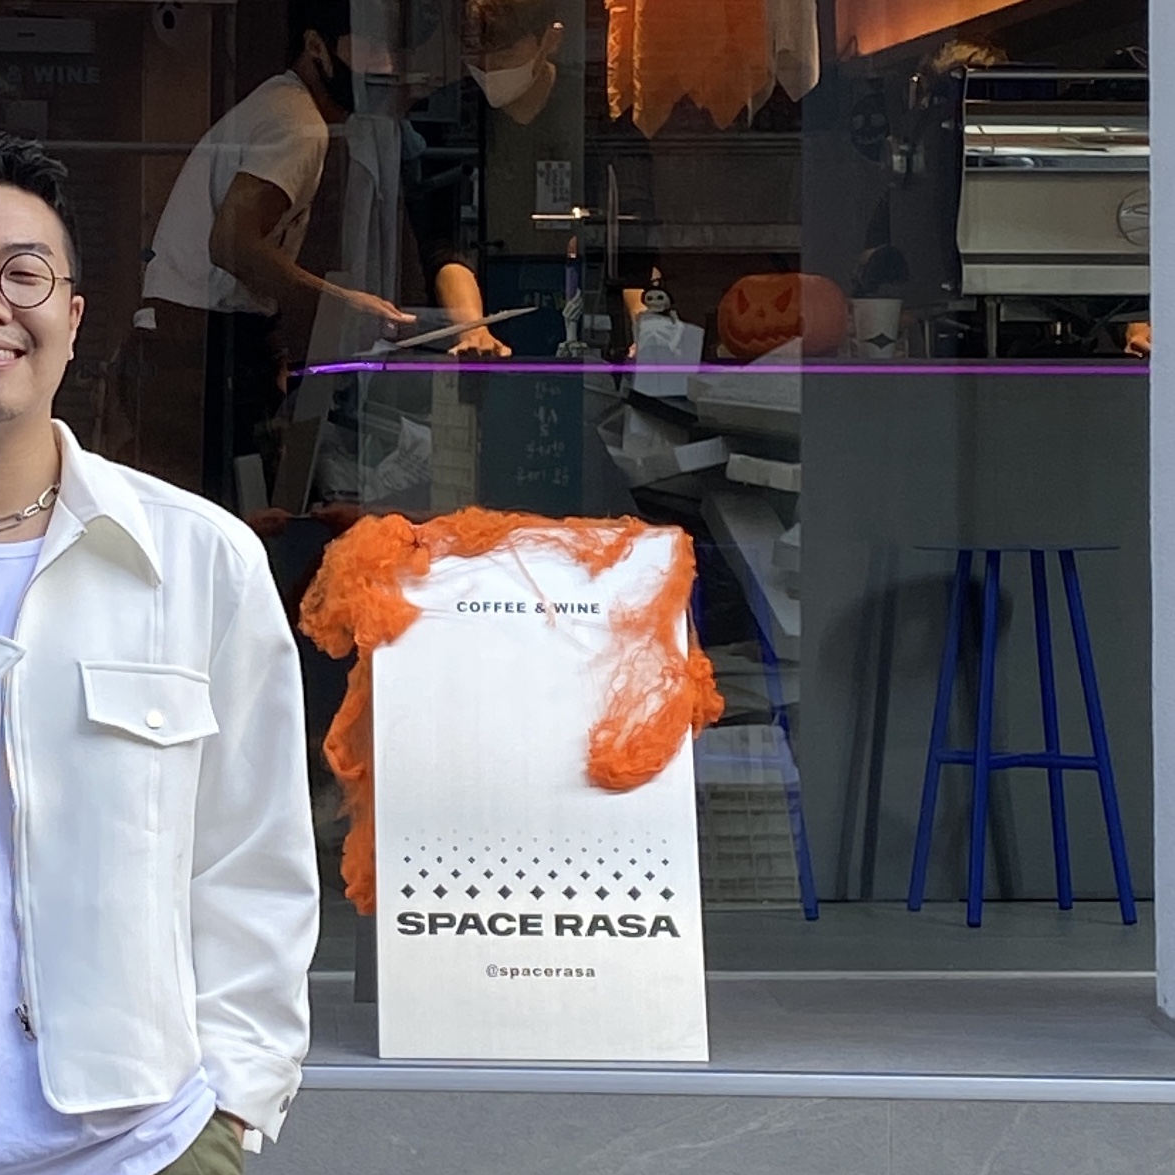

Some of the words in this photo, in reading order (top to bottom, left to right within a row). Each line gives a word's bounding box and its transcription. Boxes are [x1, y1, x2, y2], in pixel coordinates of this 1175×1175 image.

[34, 65, 101, 84] WINE
[456, 600, 526, 614] COFFEE
[534, 601, 547, 614] &
[553, 602, 601, 614] WINE
[396, 911, 544, 937] SPACE
[554, 913, 681, 938] RASA
[485, 963, 596, 979] @spacerasa
